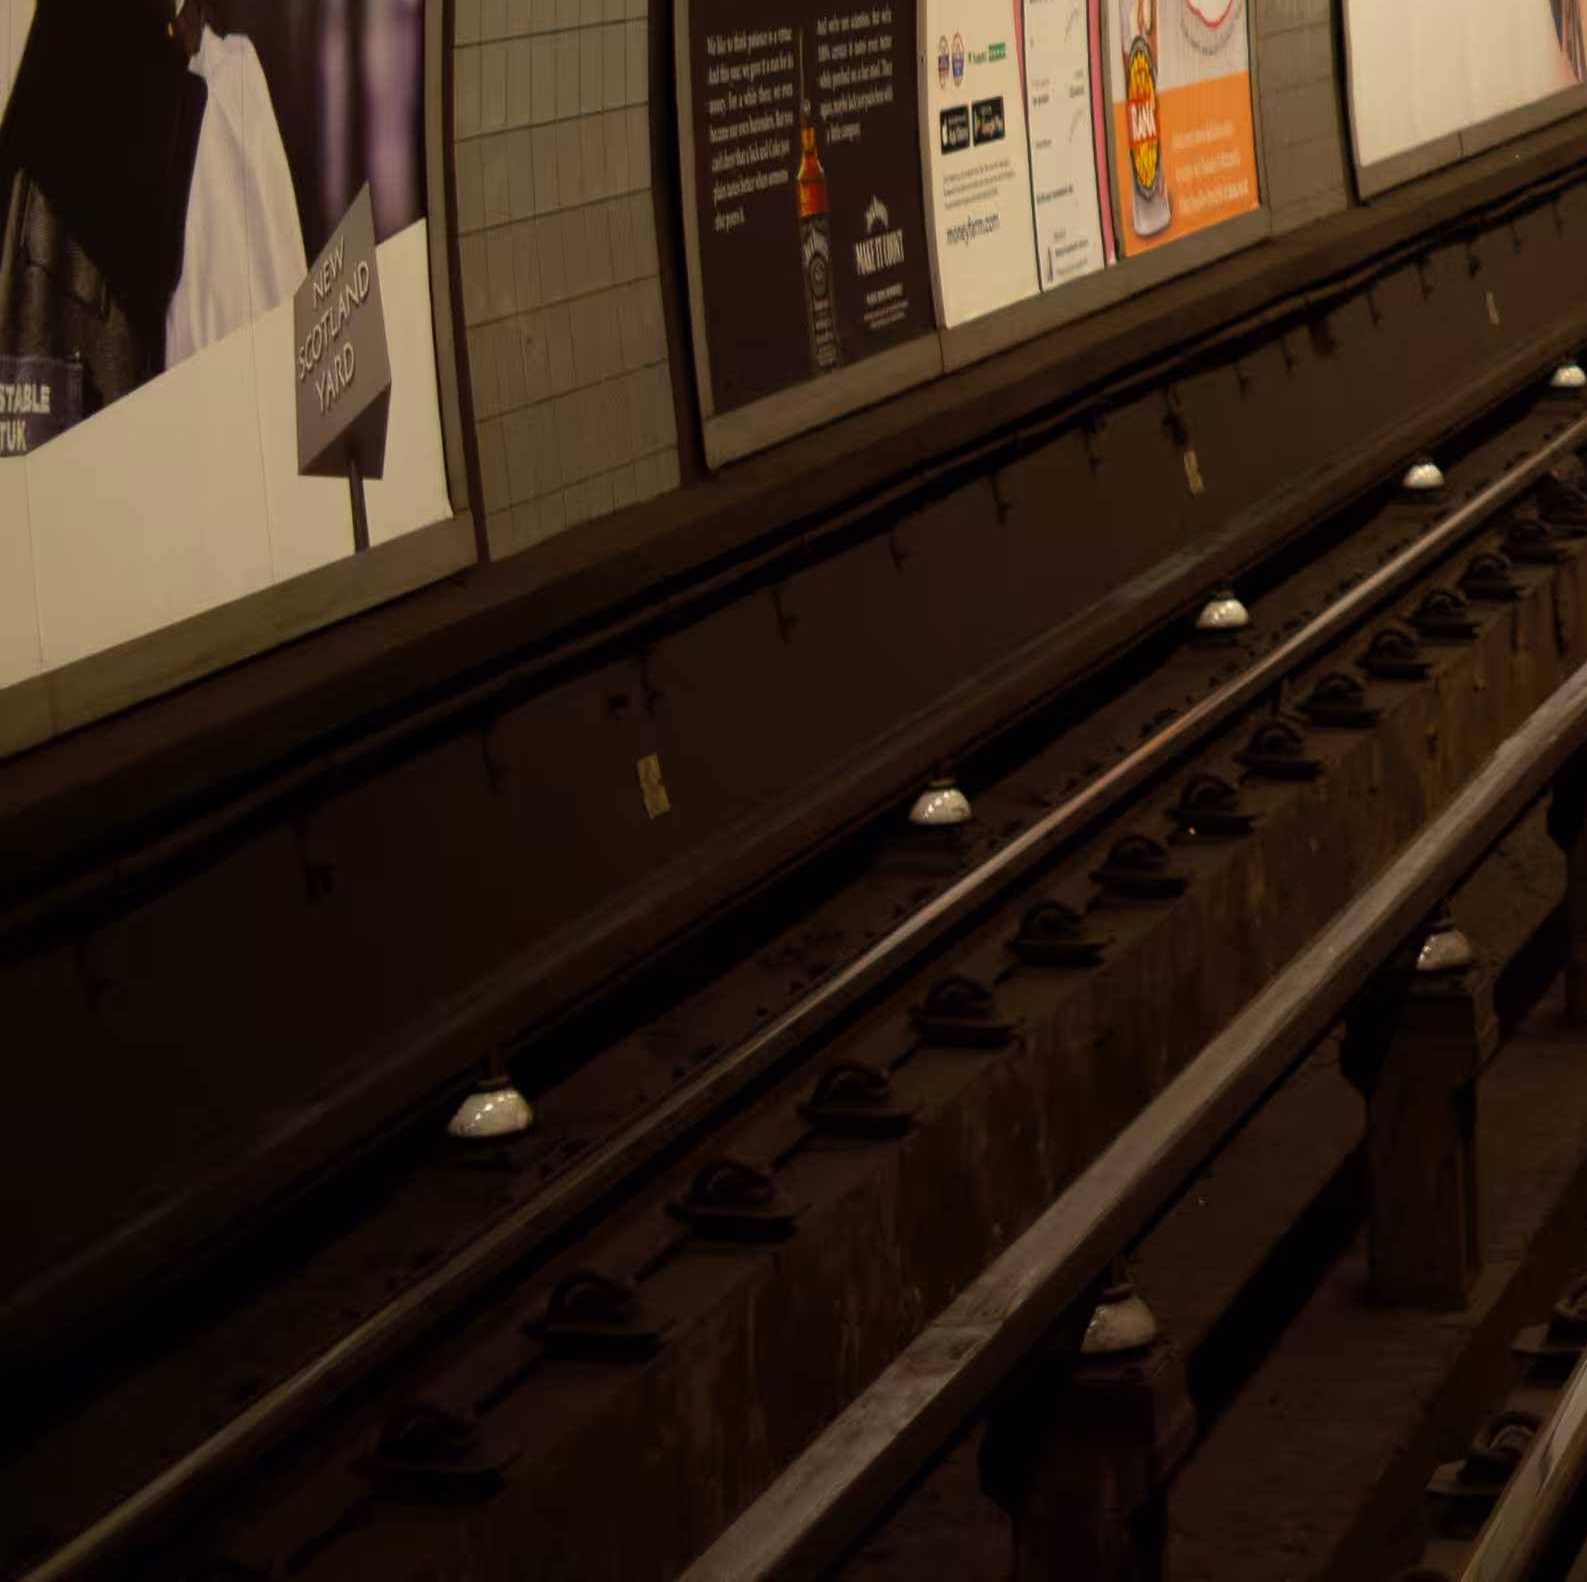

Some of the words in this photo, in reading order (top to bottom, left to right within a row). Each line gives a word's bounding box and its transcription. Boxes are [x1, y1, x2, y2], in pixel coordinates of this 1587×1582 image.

[947, 214, 1000, 246] moneyfarm.com
[311, 237, 345, 306] NEW
[298, 260, 371, 382] SCOTLAND
[314, 341, 356, 412] YARD
